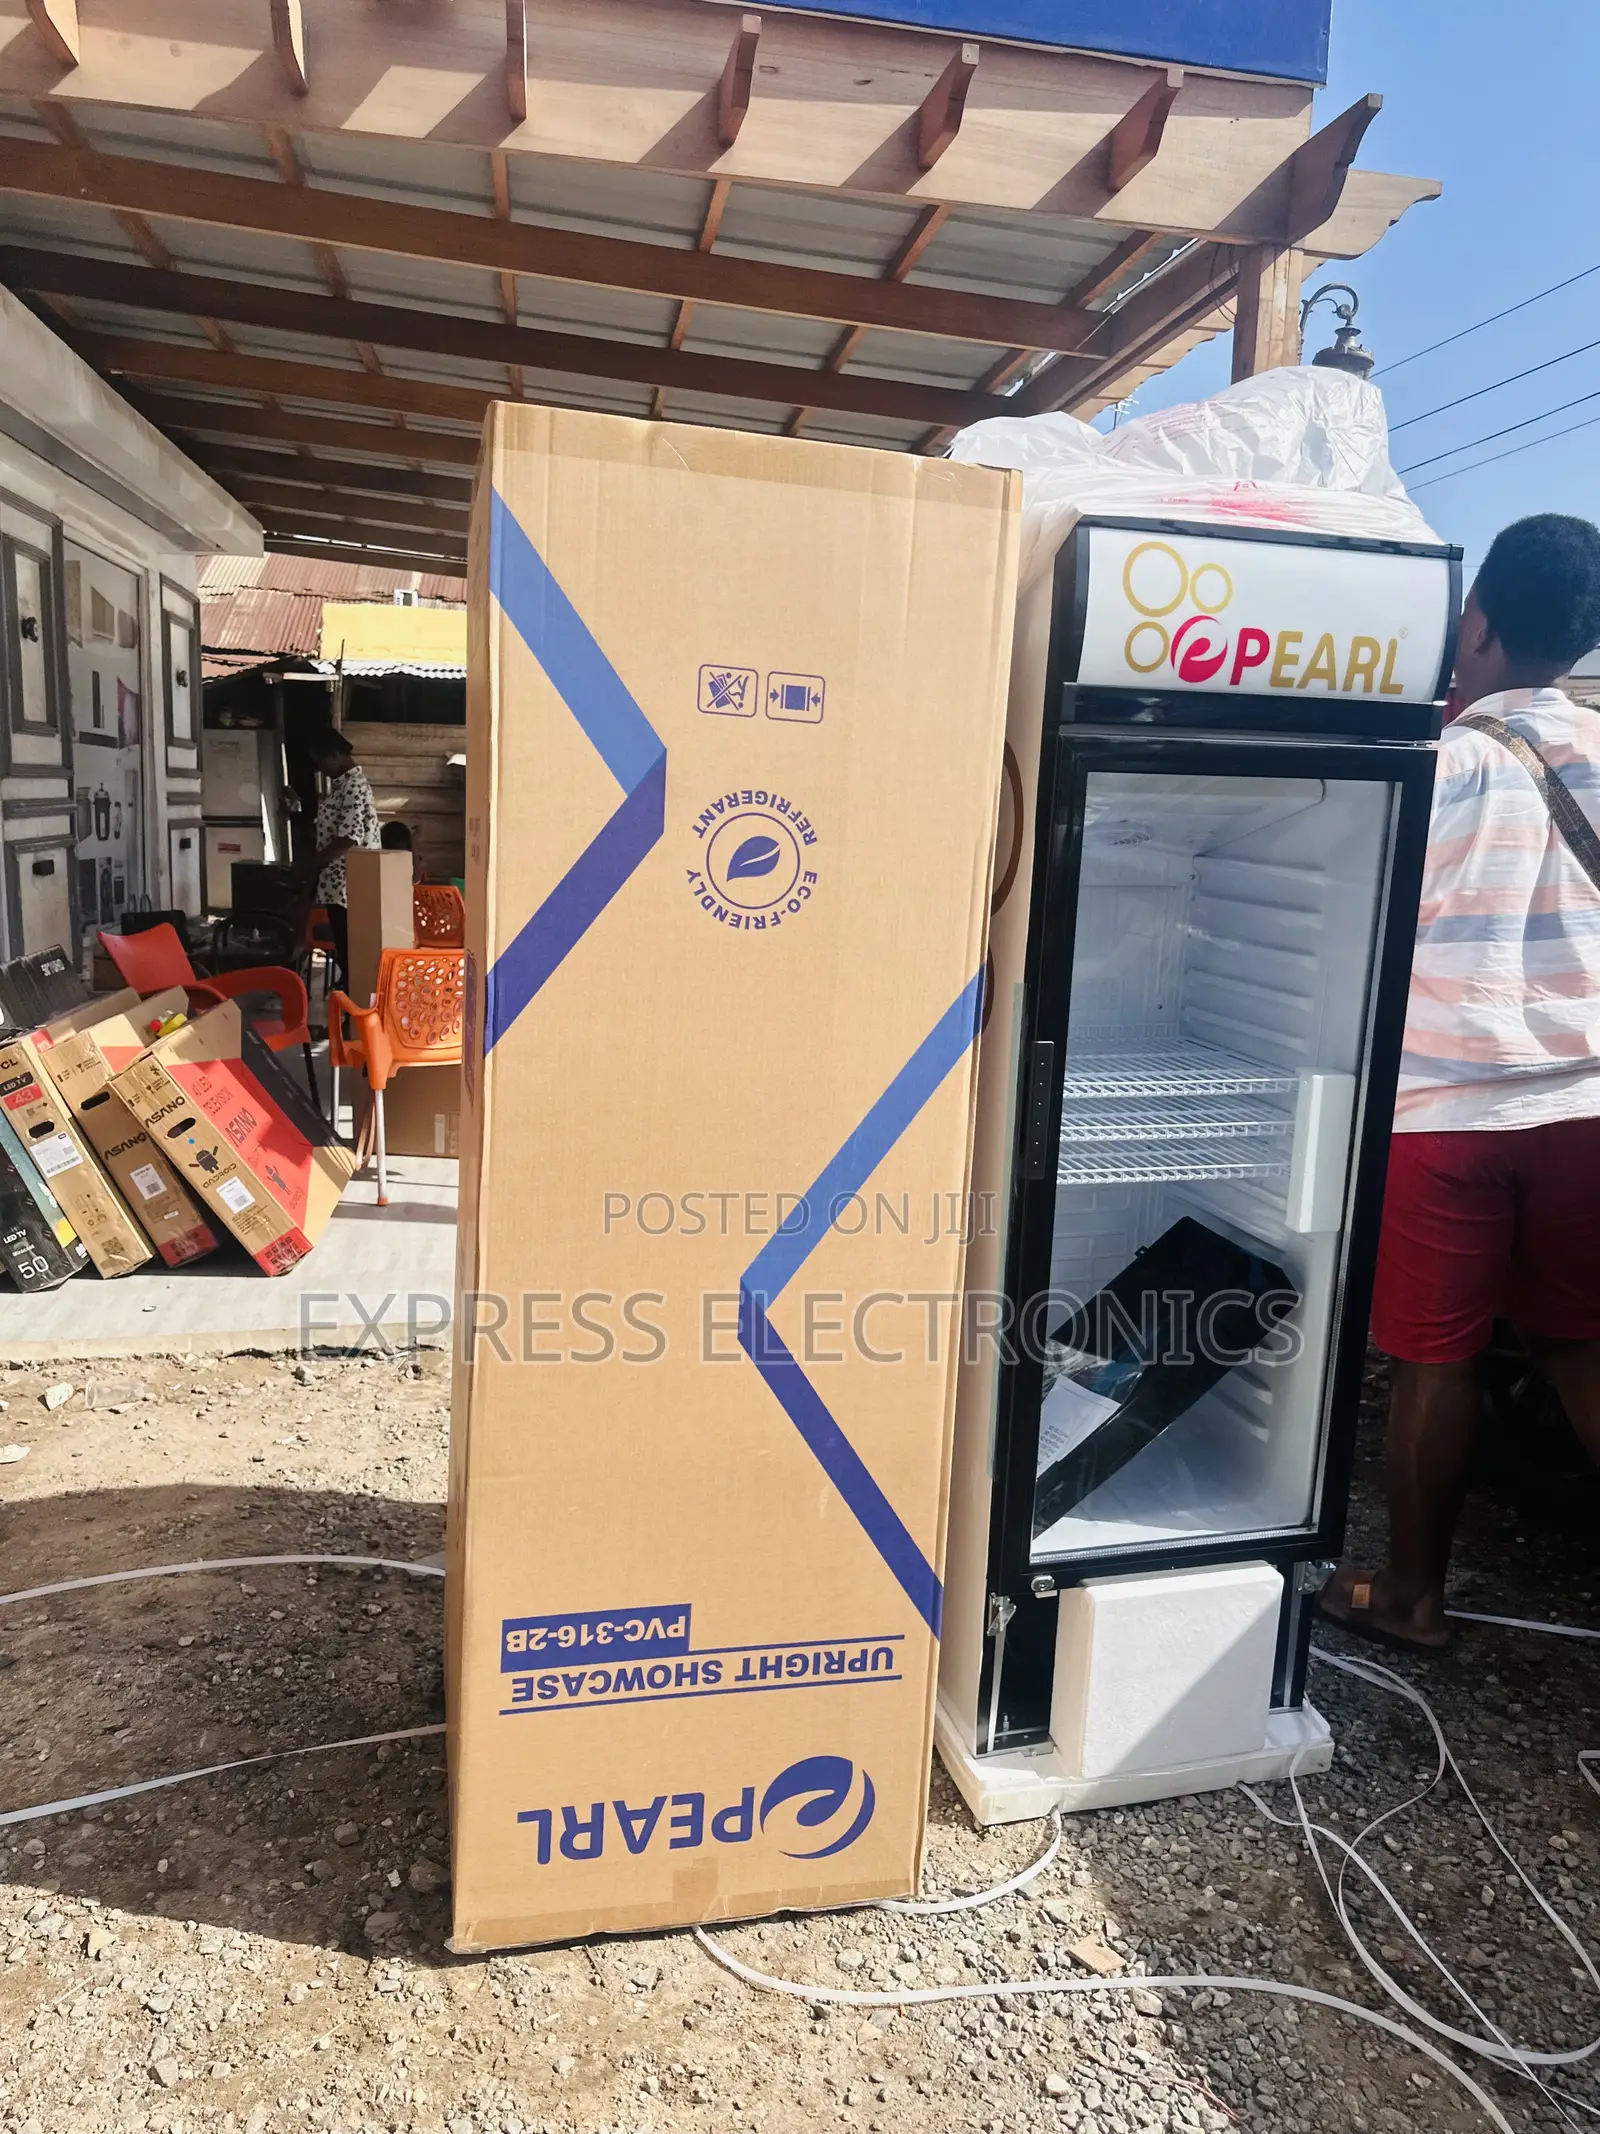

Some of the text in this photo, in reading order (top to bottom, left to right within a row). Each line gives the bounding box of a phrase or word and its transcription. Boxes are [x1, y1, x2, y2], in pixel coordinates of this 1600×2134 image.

[1229, 627, 1404, 694] PEARL
[691, 789, 818, 847] REFRIGERANT
[685, 868, 818, 930] ECO-FRIENDLY
[0, 1058, 18, 1070] CL
[15, 1089, 34, 1106] 43
[144, 1095, 186, 1129] ASANO
[202, 1085, 234, 1117] TELEVISION
[224, 1106, 258, 1149] ASANO
[104, 1131, 148, 1161] ASANO
[3, 1229, 27, 1244] LED TV
[17, 1255, 50, 1280] 50
[506, 1615, 686, 1653] PVC-316-2B
[511, 1646, 894, 1703] UPRIGHT SHOWCASE
[516, 1786, 756, 1865] PEARL
